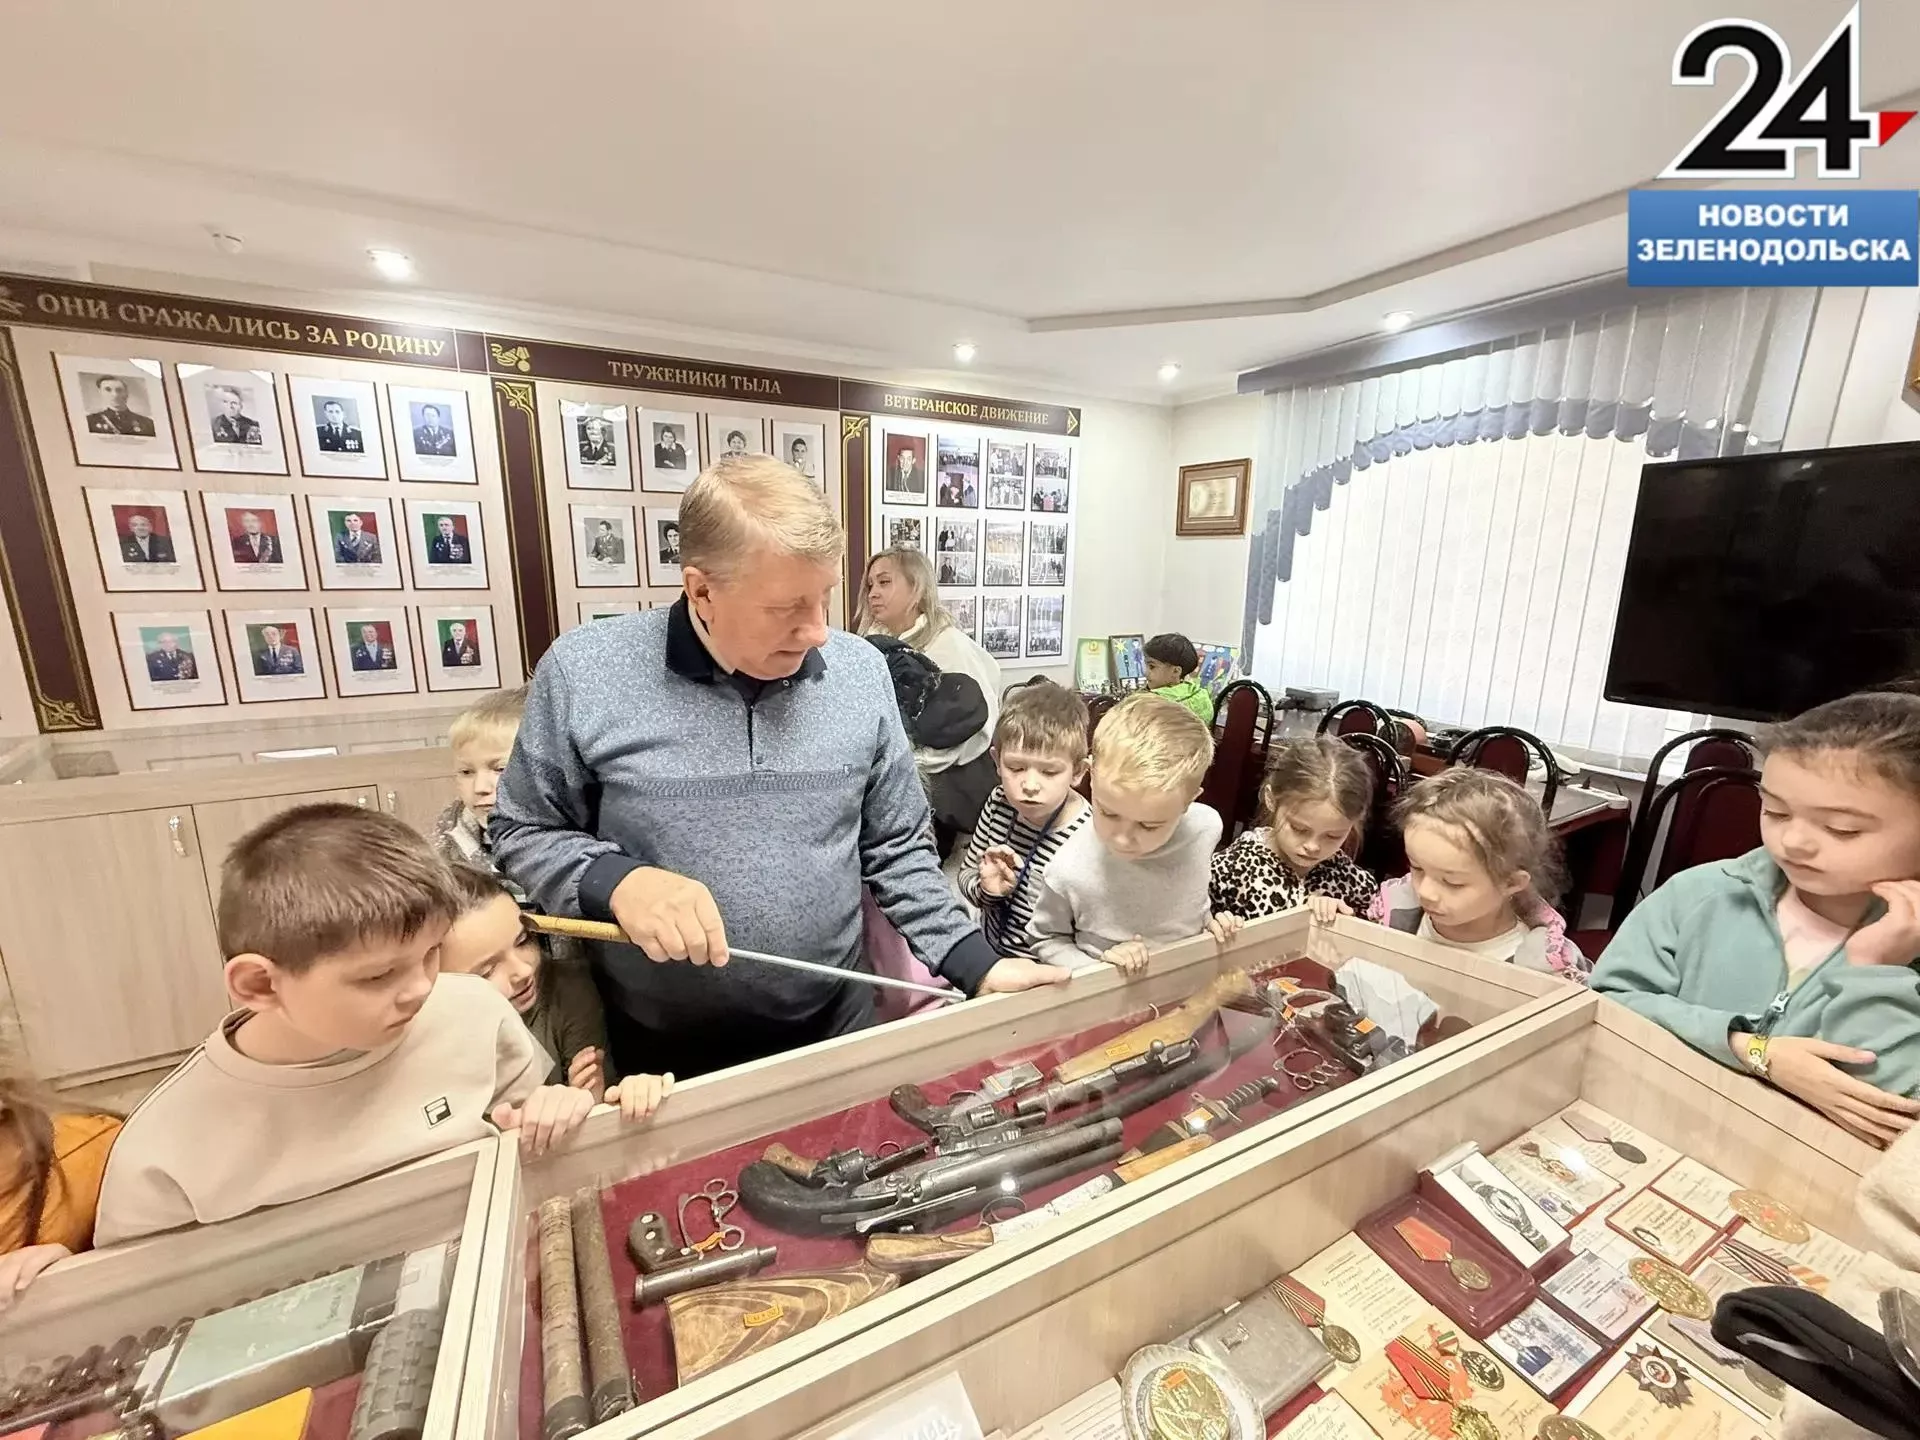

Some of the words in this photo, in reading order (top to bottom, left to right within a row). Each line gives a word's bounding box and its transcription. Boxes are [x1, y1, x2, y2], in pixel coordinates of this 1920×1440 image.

[36, 293, 110, 320] ОНИ
[118, 303, 300, 341] СРАЖАЛИСЬ
[305, 325, 340, 346] ЗА
[344, 329, 446, 357] РОДИНУ
[607, 360, 728, 389] ТРУЖЕНИКИ
[731, 375, 783, 395] ТЫЛА
[883, 393, 979, 418] ВЕТЕРАНСКОЕ
[980, 406, 1050, 426] ДВИЖЕНИЕ
